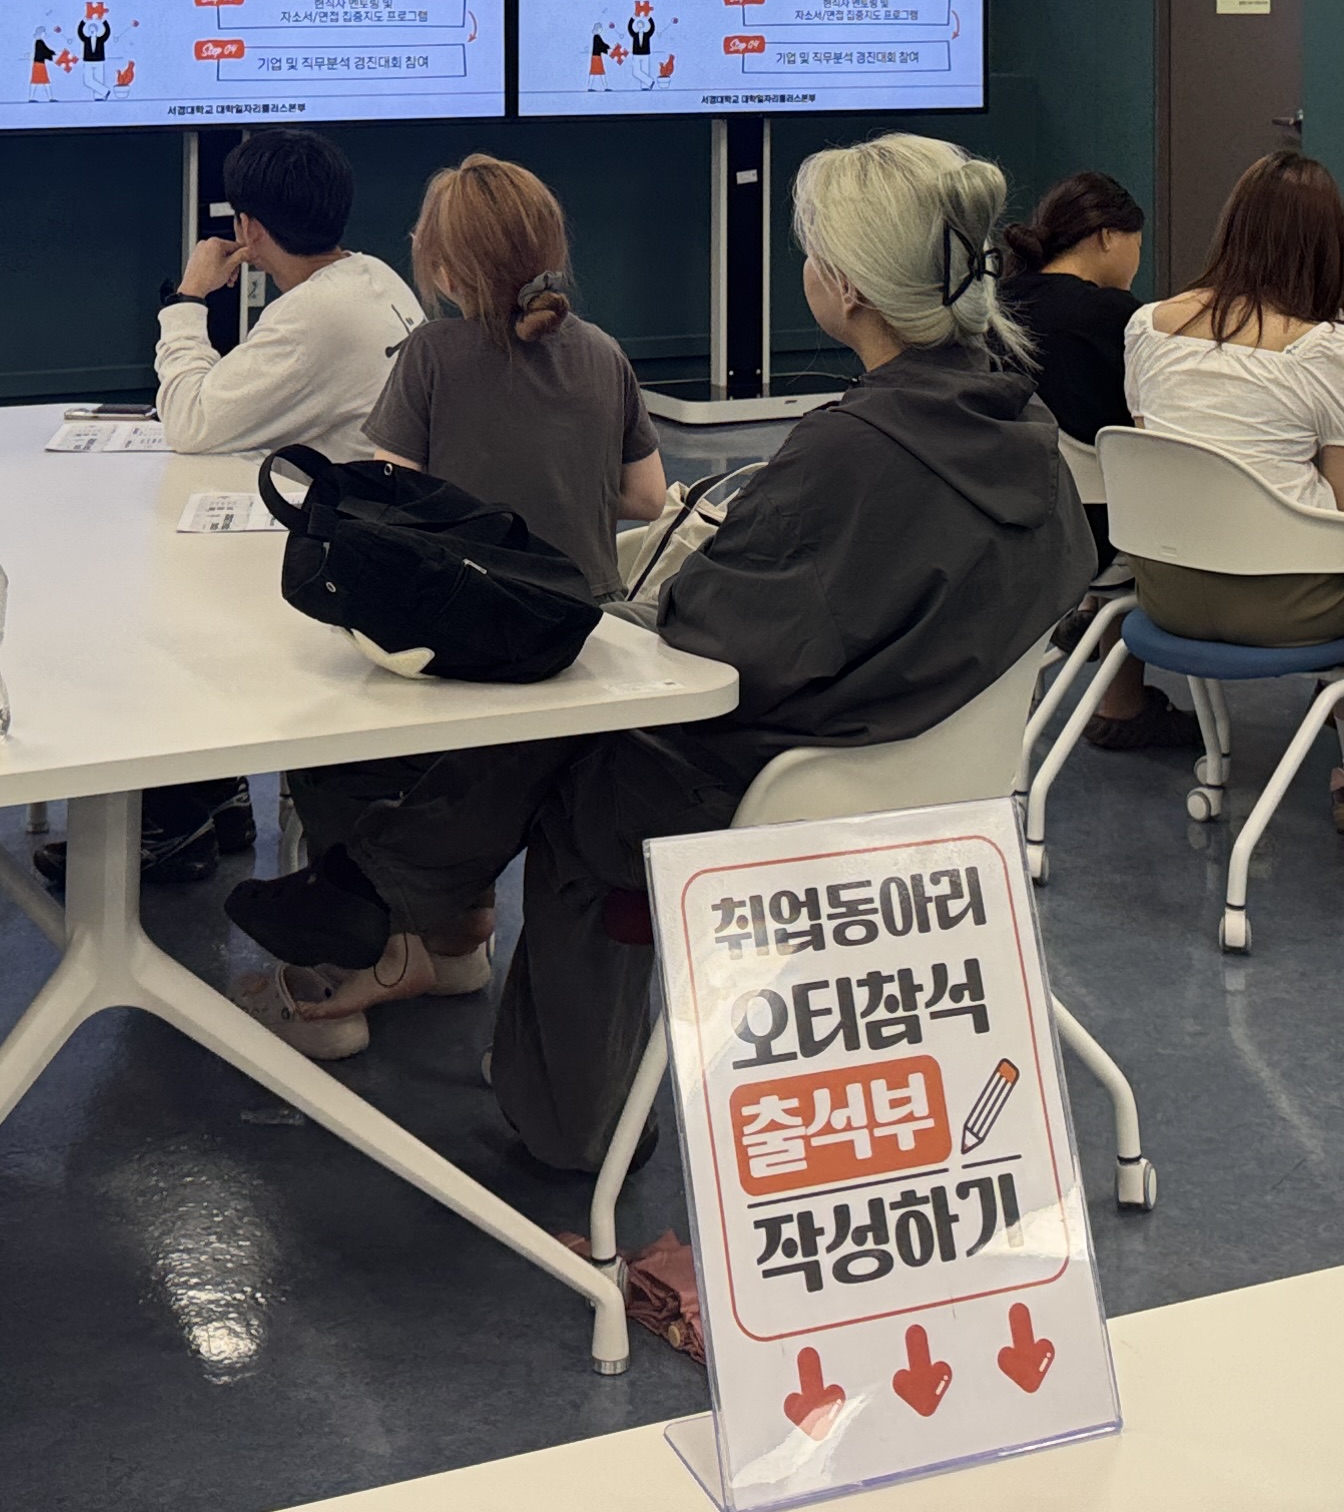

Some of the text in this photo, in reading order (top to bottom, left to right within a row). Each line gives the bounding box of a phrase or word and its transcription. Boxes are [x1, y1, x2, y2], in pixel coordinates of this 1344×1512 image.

[386, 10, 429, 23] 프로그램
[883, 9, 919, 21] 프로그램
[711, 866, 987, 961] 취업동아리
[731, 958, 990, 1070] 오티참석
[740, 1072, 936, 1179] 출석부
[754, 1173, 1022, 1292] 작성하기
